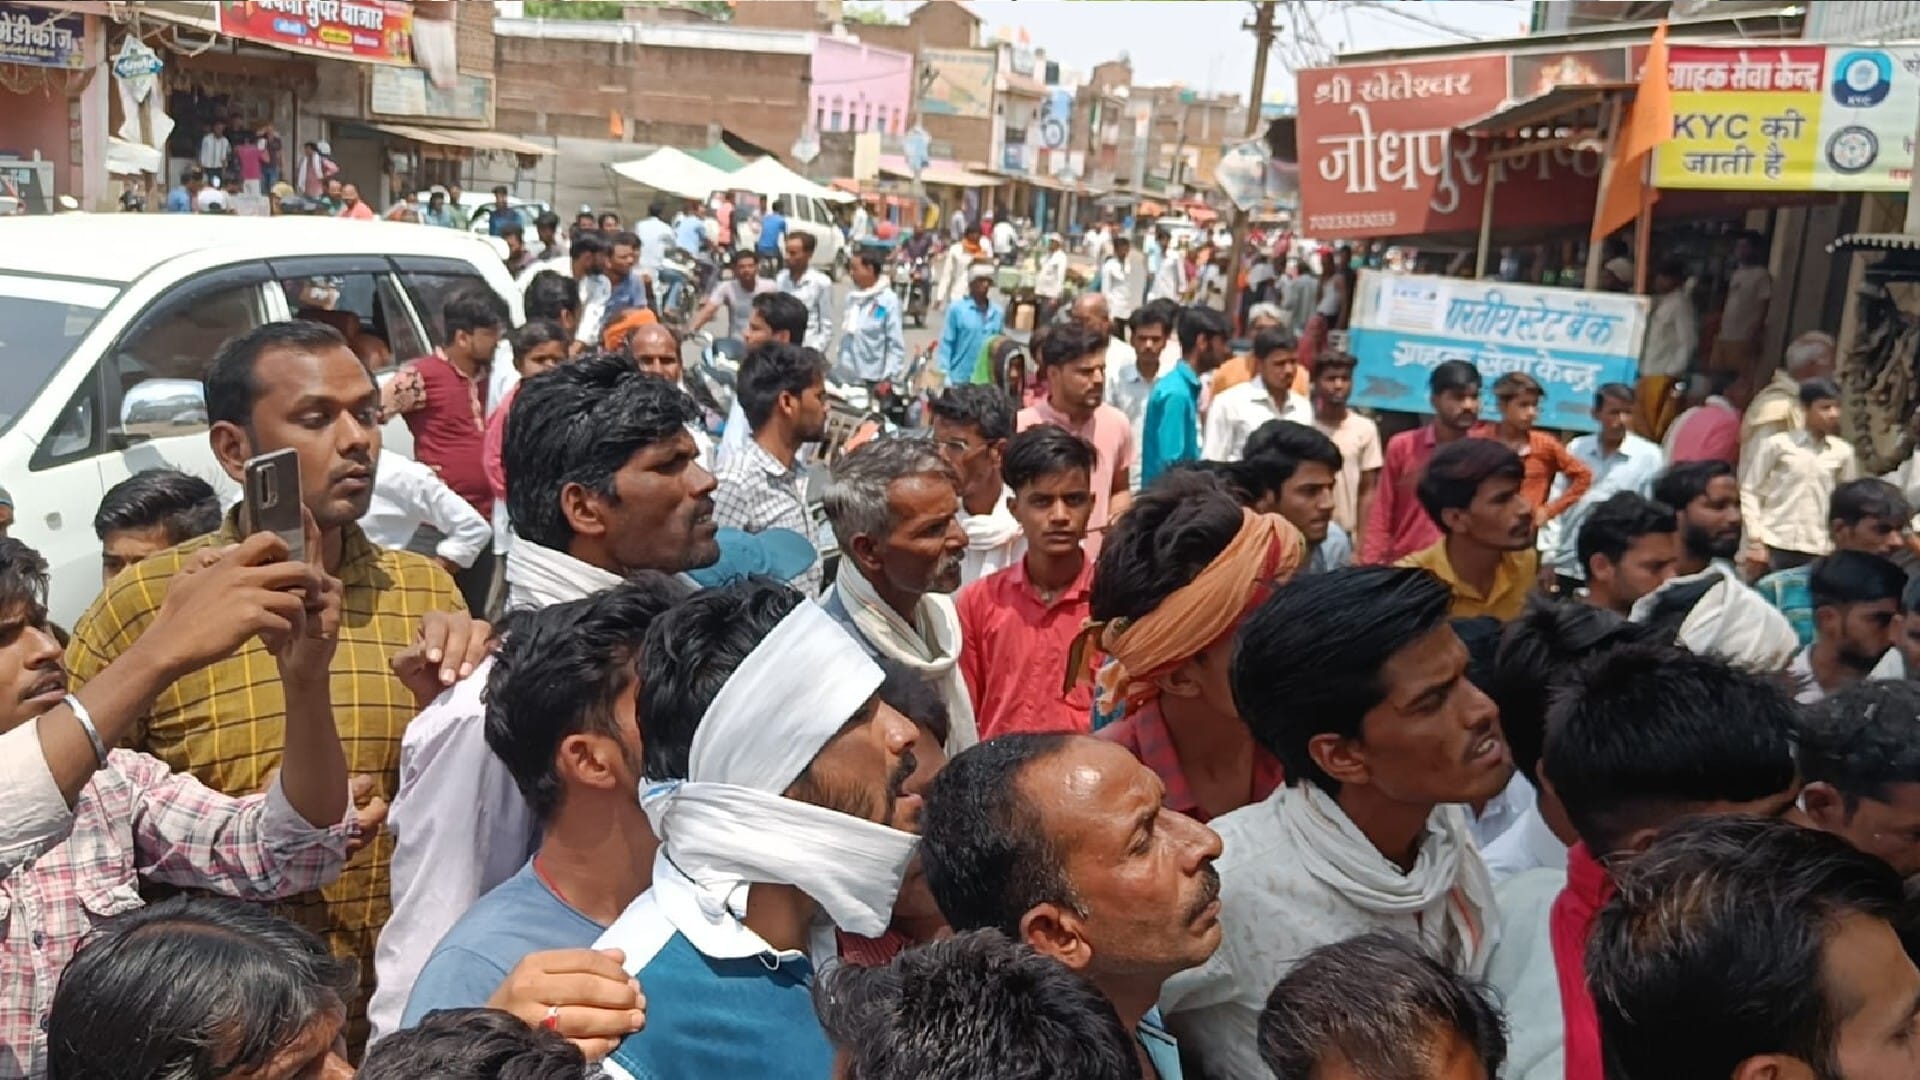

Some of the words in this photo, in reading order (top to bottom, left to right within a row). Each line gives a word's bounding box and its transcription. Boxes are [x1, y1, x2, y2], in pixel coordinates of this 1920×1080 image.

[305, 1, 341, 28] सुपर
[341, 3, 384, 31] बाजार
[1314, 74, 1351, 104] श्री
[1358, 70, 1472, 101] खेतेश्वर
[1730, 51, 1773, 90] सेवा
[1773, 50, 1821, 92] केन्द्र
[1673, 113, 1749, 140] KYC
[1760, 108, 1806, 140] की
[1317, 104, 1482, 213] जोधपुर
[1682, 144, 1755, 175] जाती
[1763, 141, 1785, 180] है
[1517, 296, 1571, 342] स्टेट
[1567, 301, 1624, 344] बैंक
[1477, 343, 1536, 377] सेवा
